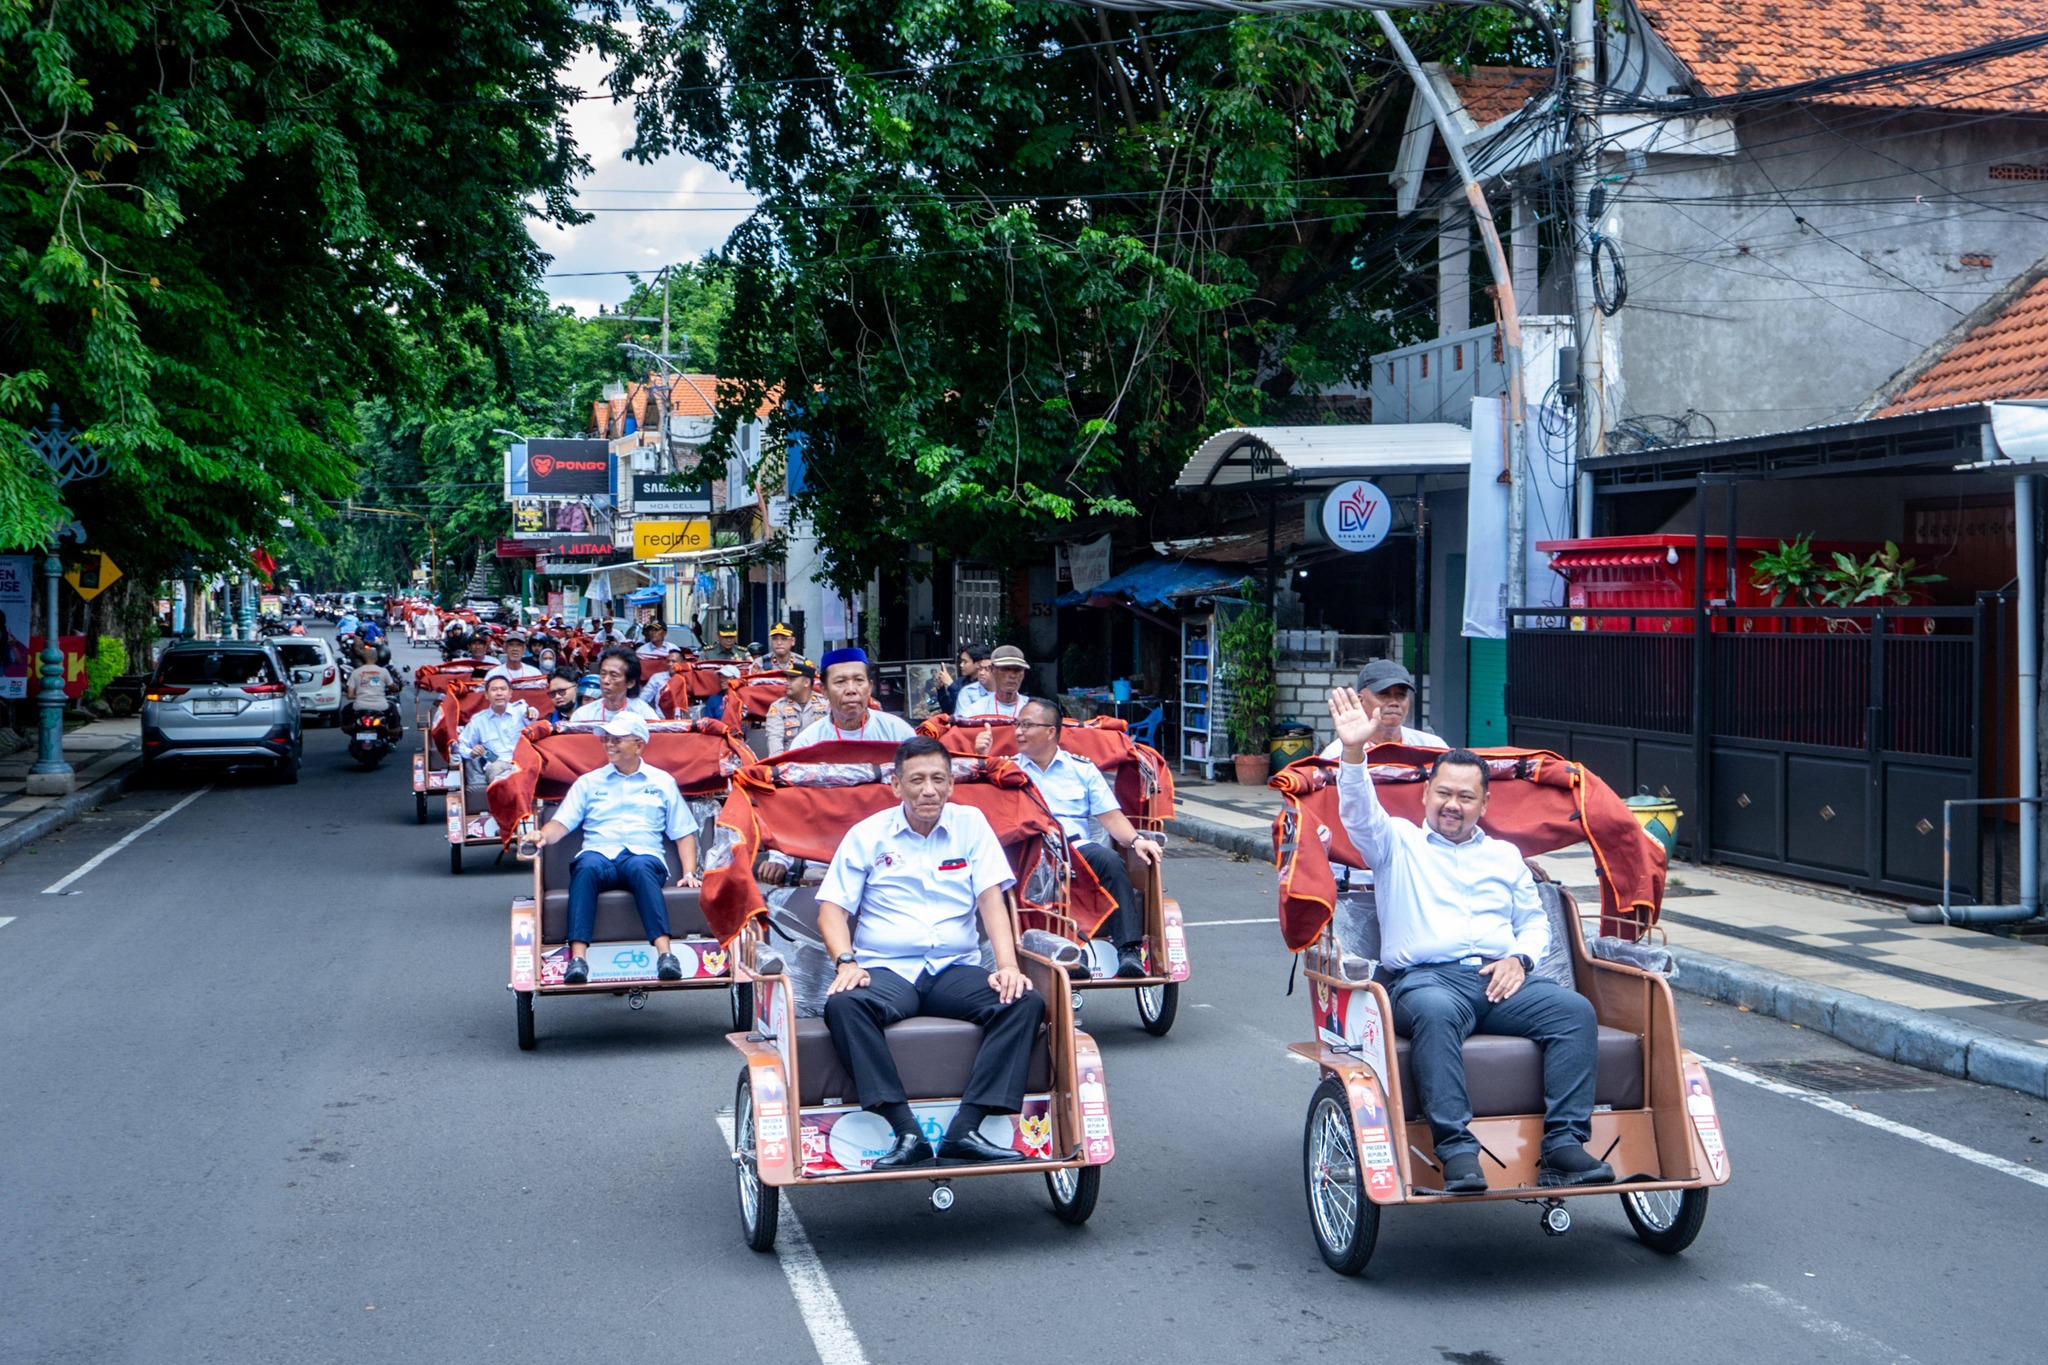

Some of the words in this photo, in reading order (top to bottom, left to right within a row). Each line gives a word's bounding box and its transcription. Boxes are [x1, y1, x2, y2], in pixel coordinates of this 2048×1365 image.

[556, 461, 607, 471] PONGO
[643, 532, 701, 546] realme
[559, 544, 565, 554] 1
